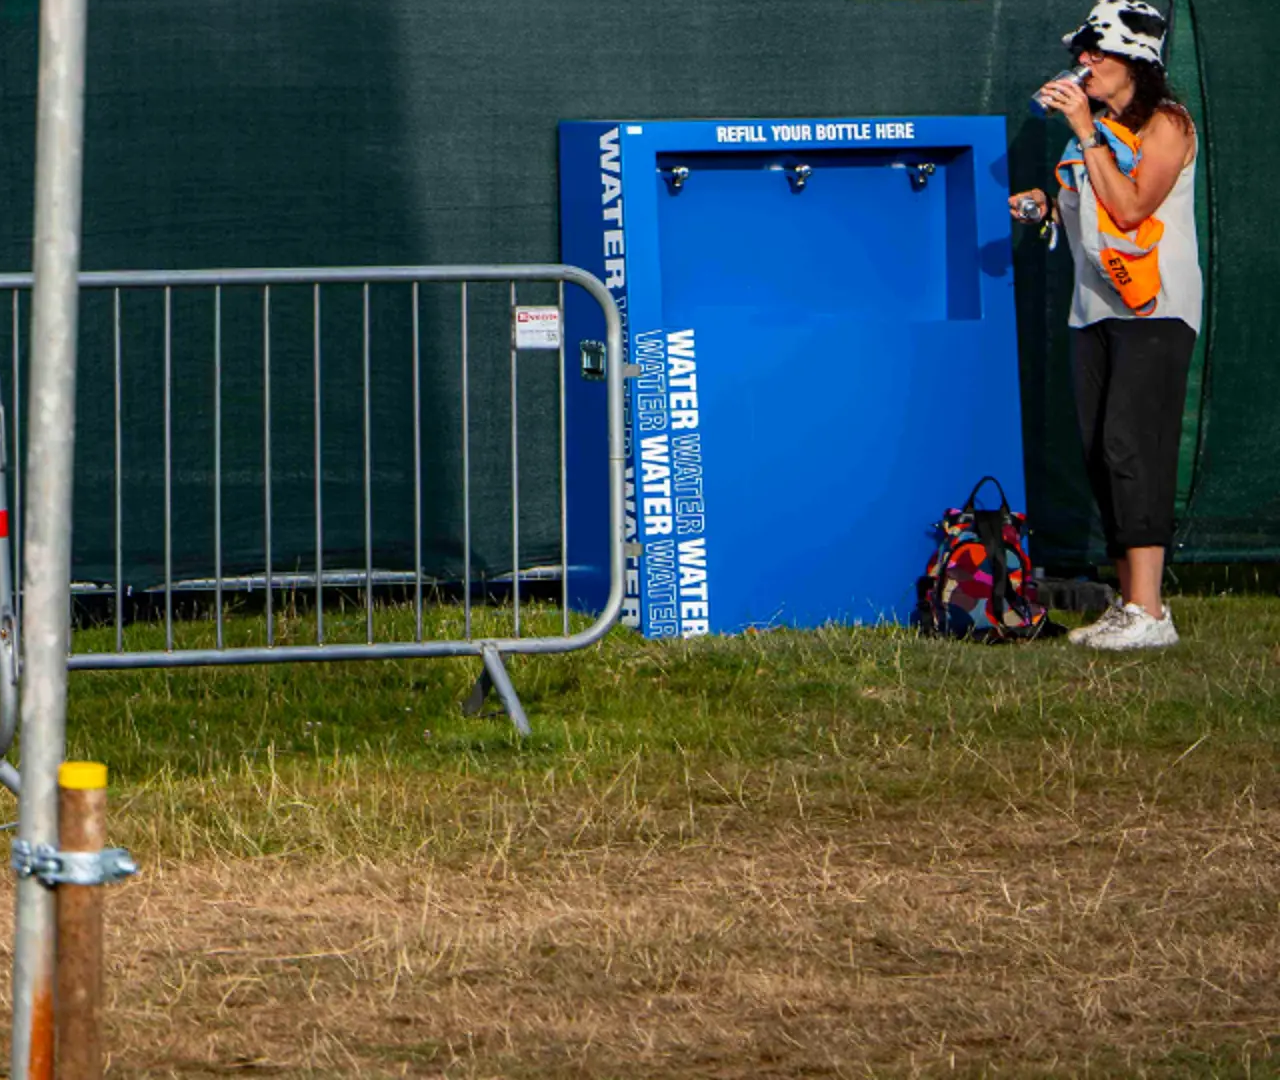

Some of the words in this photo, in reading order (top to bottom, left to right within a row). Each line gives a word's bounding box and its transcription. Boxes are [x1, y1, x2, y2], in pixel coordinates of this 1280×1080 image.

[716, 126, 767, 143] REFILL
[771, 124, 812, 141] YOUR
[816, 123, 871, 140] BOTTLE
[875, 122, 915, 139] HERE
[599, 127, 625, 290] WATER
[635, 329, 668, 431] WATER
[668, 329, 699, 431] WATER
[640, 434, 673, 536] WATER
[672, 433, 705, 535] WATER
[646, 539, 678, 637] WATER
[678, 538, 708, 639] WATER
